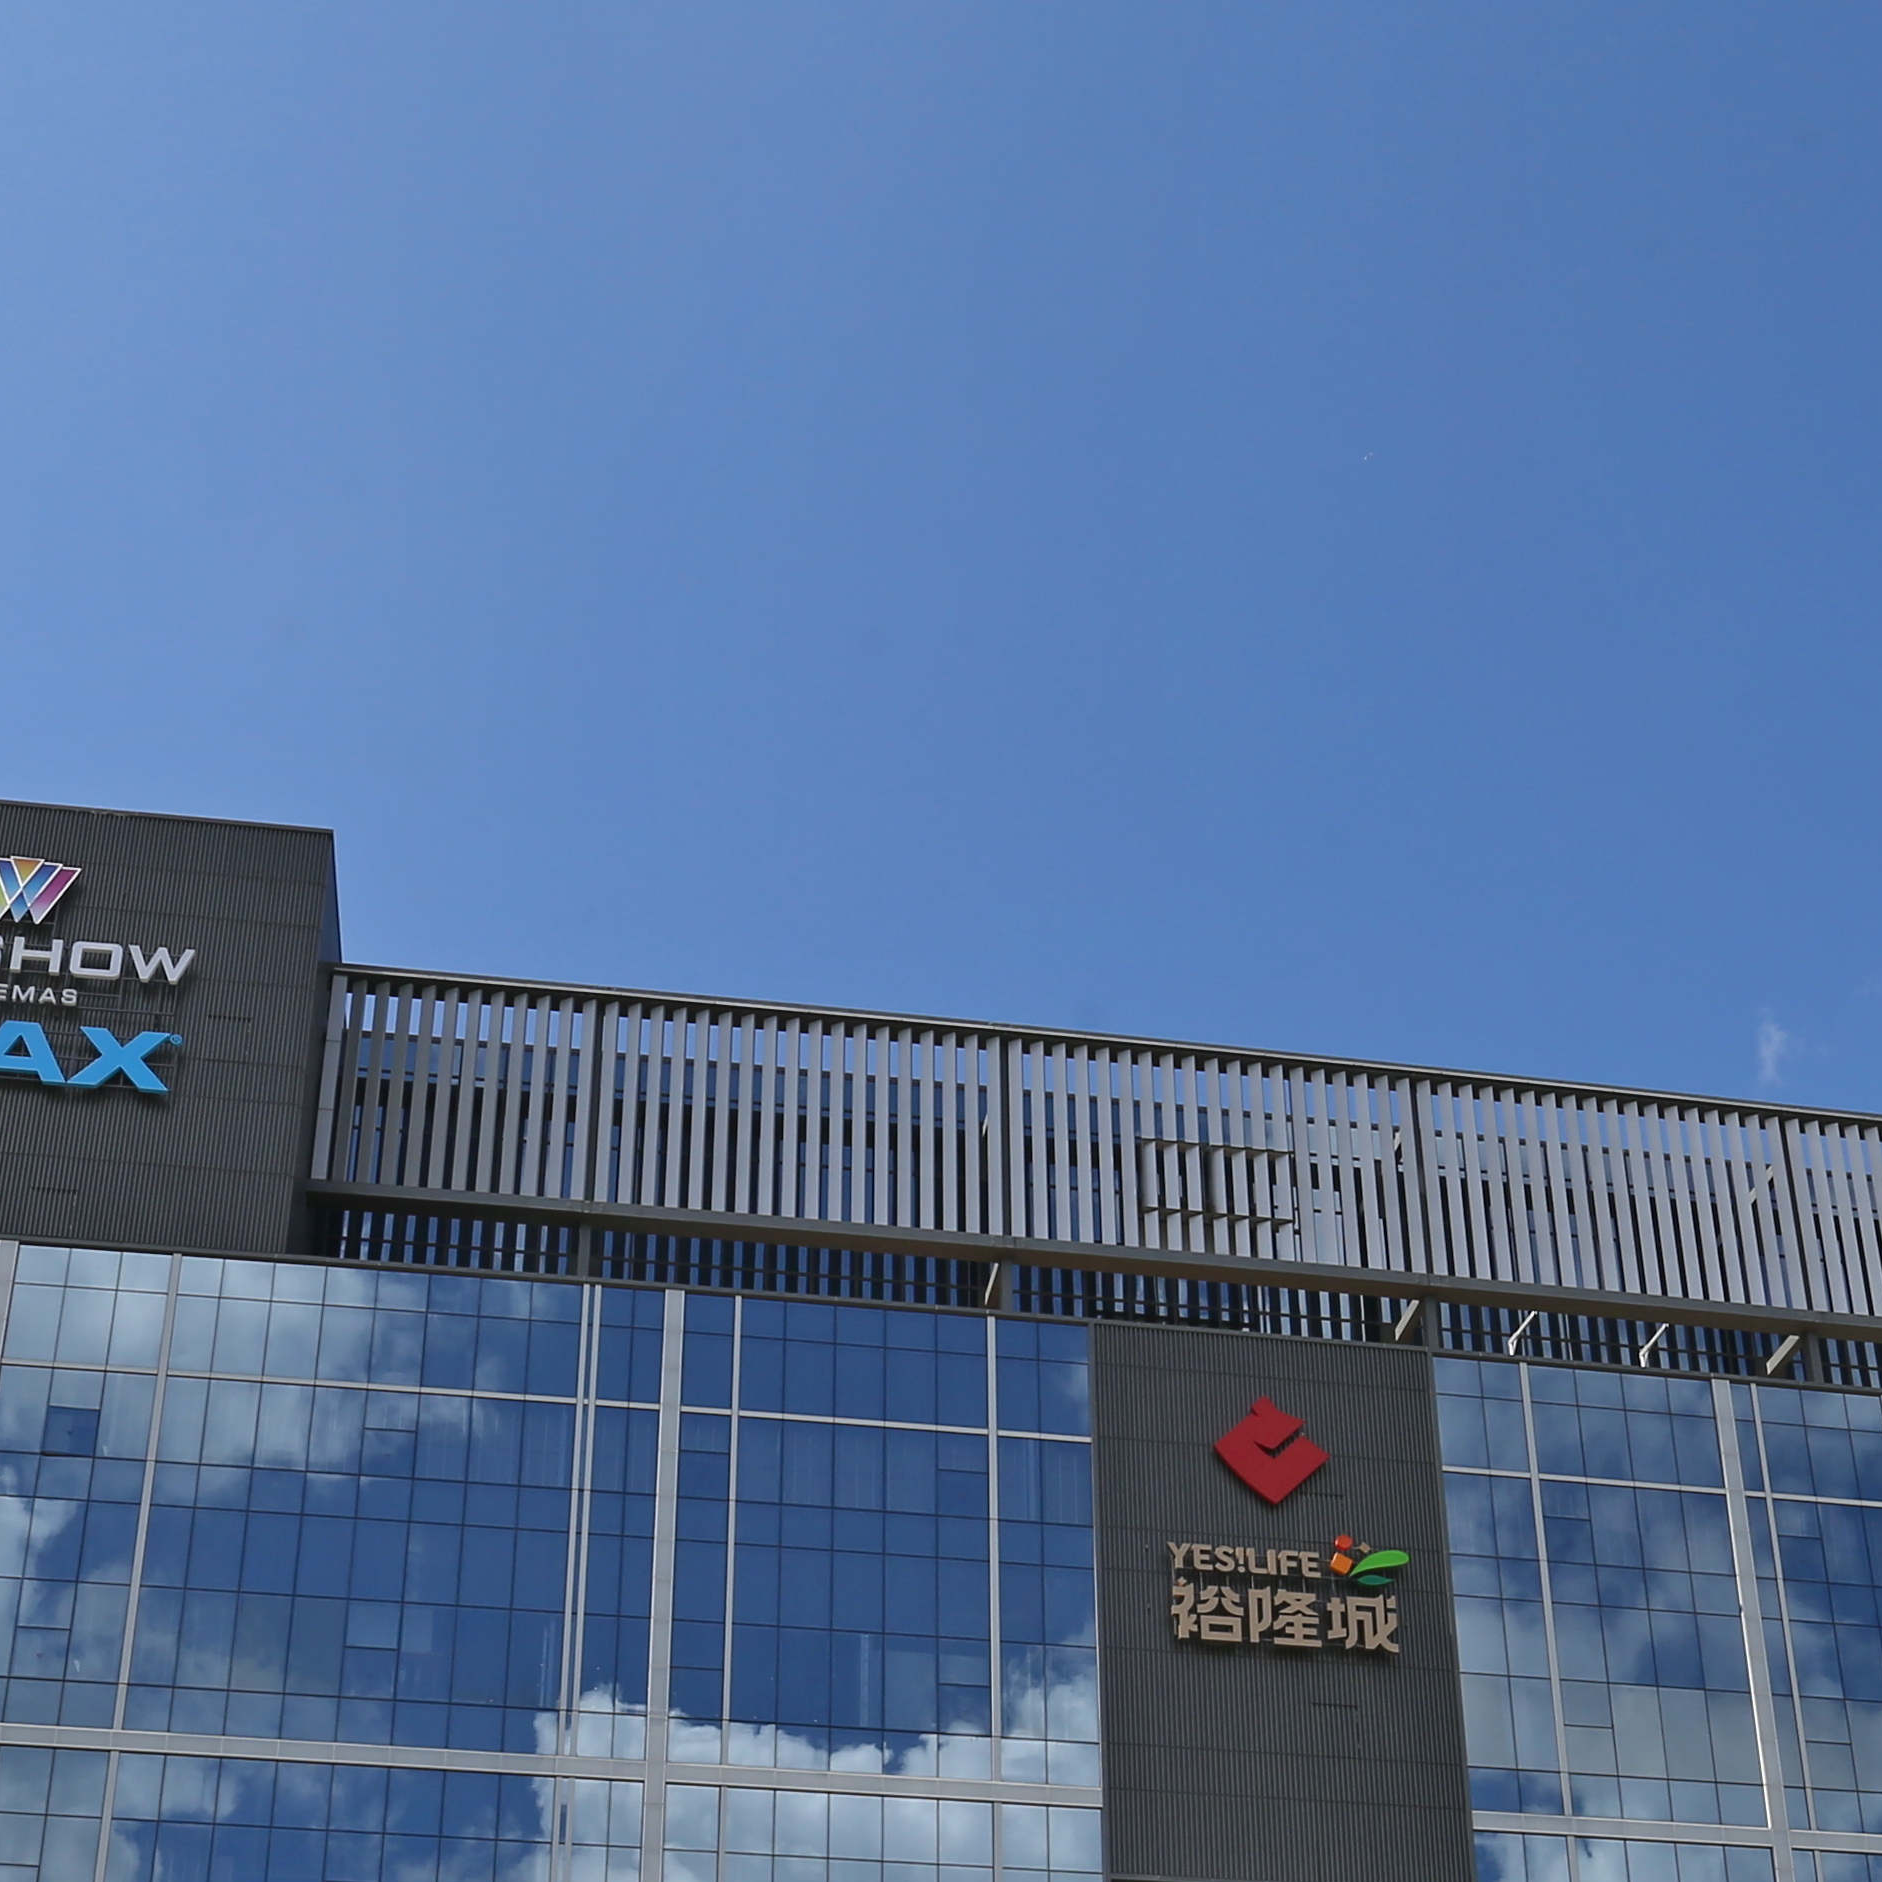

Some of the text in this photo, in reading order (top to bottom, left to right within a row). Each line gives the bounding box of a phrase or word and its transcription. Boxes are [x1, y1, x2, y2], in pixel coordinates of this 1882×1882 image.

[1167, 1541, 1322, 1578] YES!LIFE
[1171, 1577, 1400, 1653] 裕隆城
